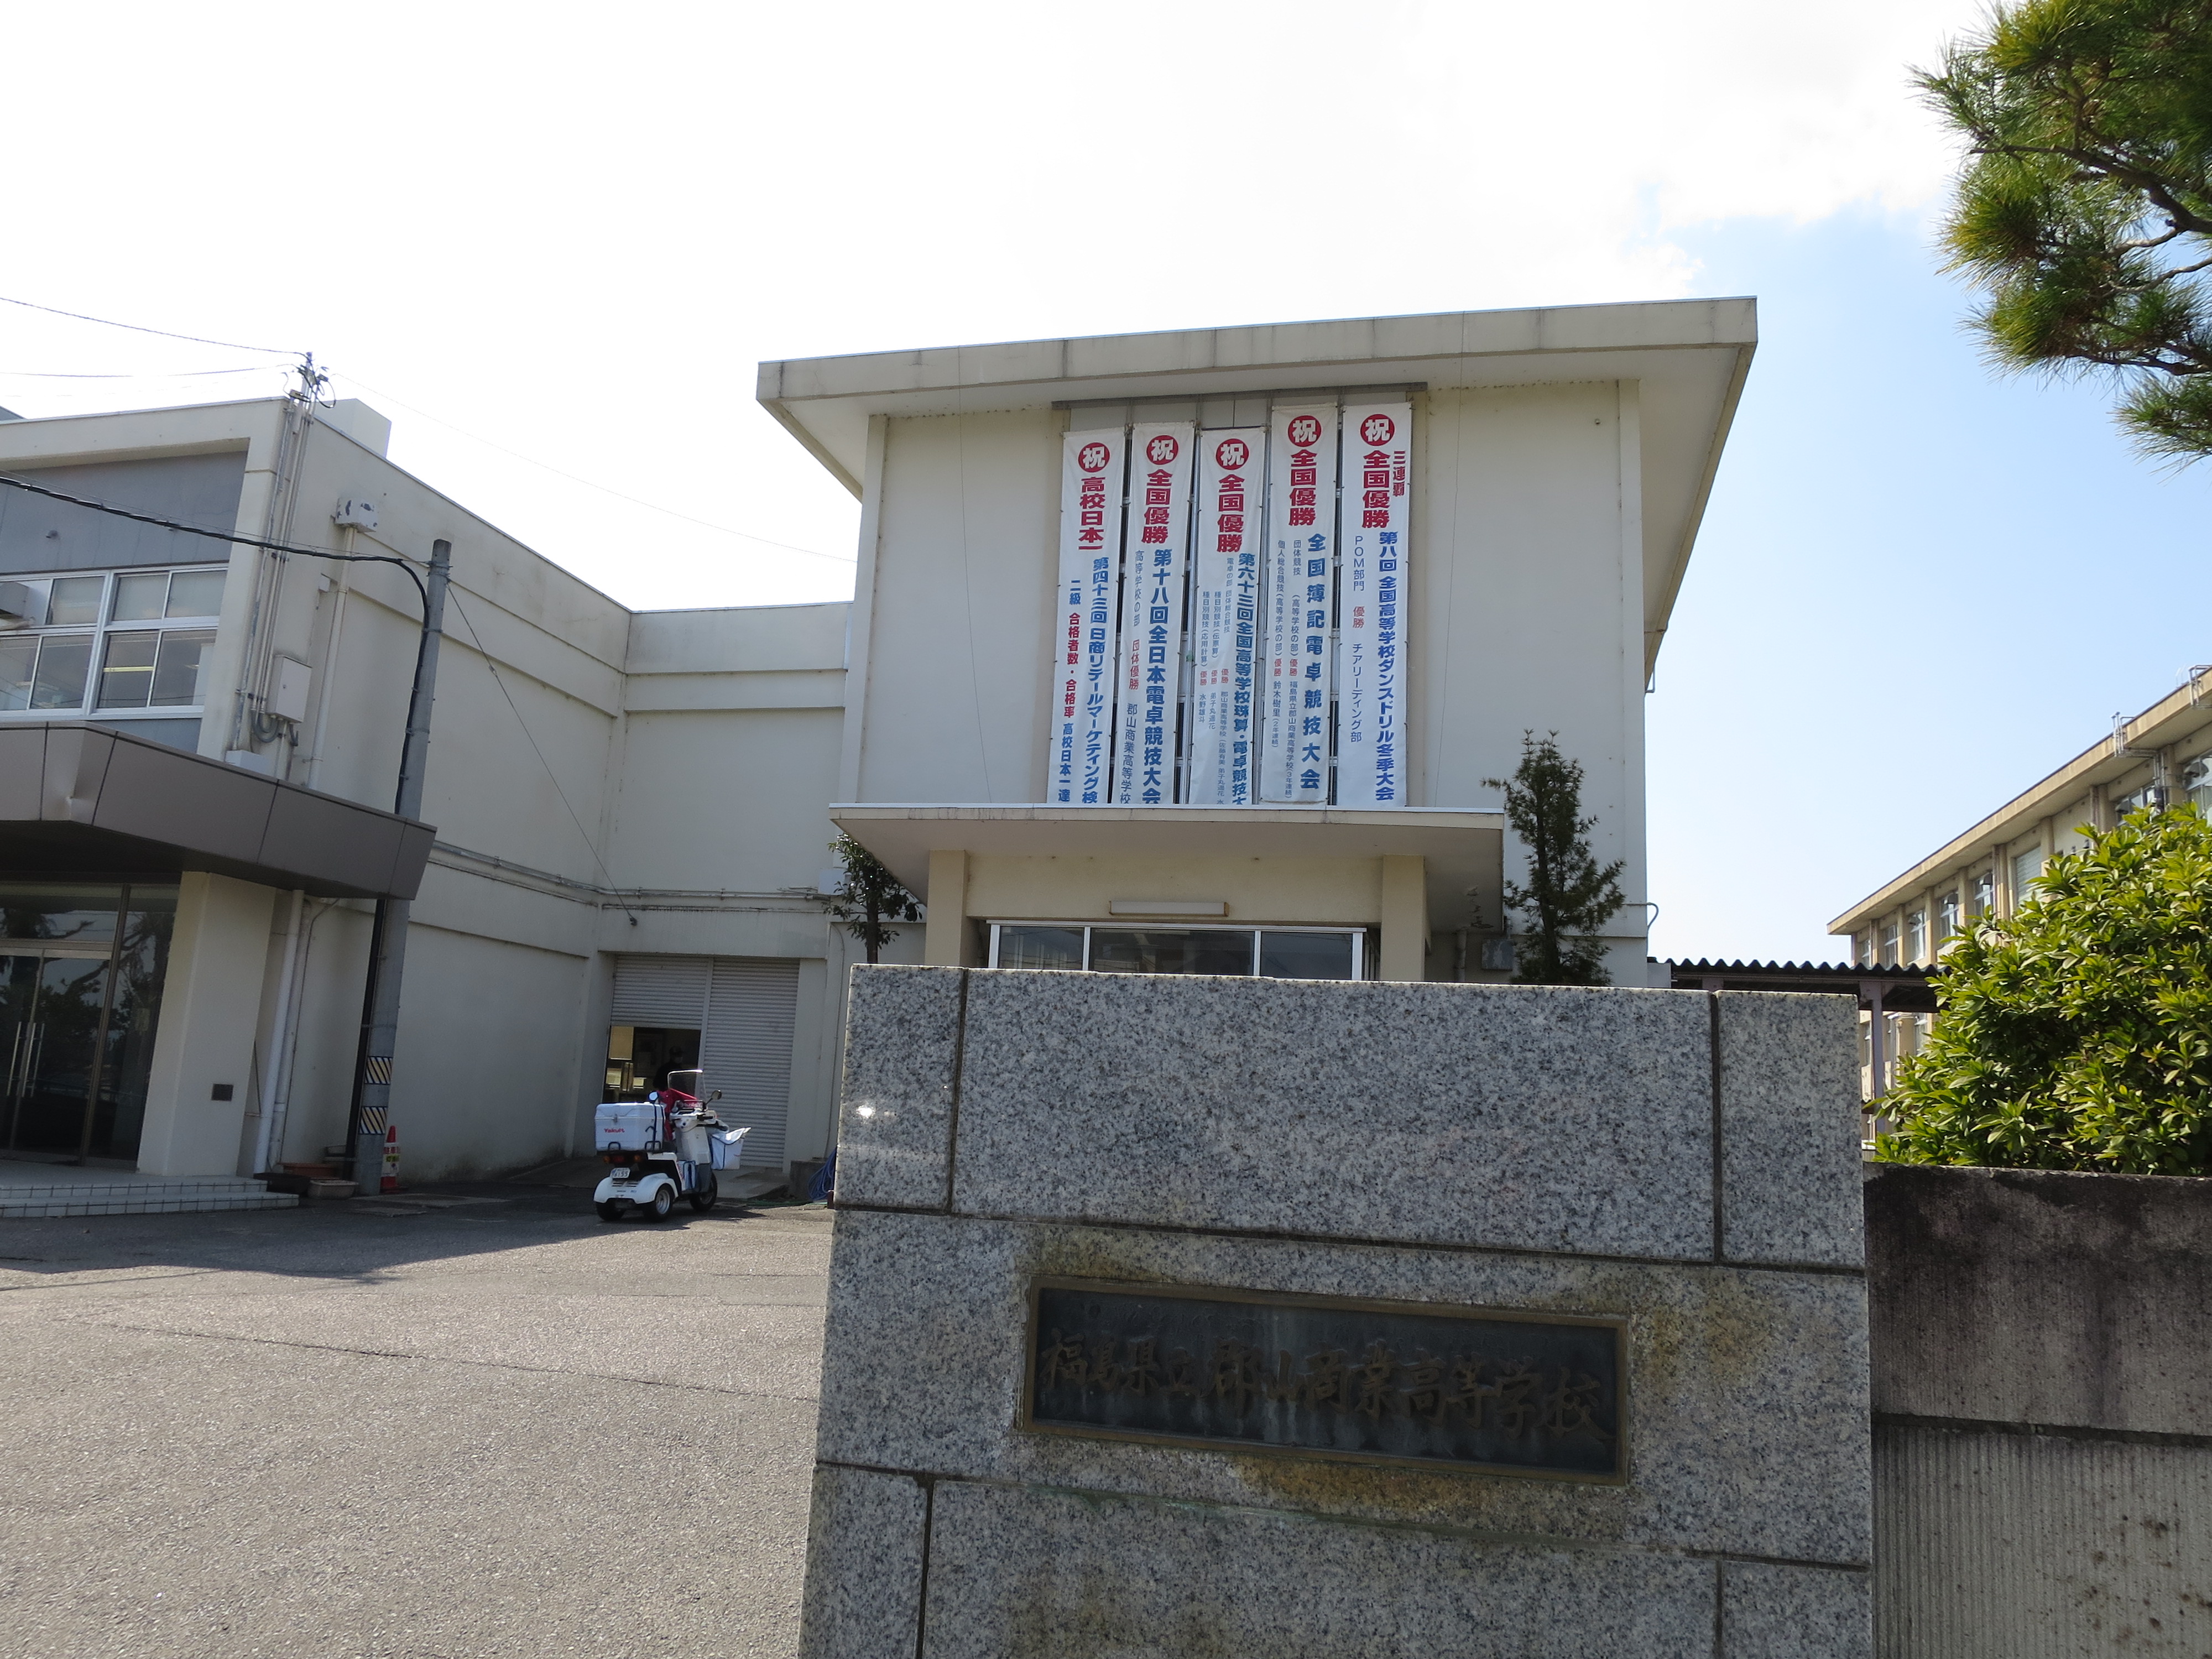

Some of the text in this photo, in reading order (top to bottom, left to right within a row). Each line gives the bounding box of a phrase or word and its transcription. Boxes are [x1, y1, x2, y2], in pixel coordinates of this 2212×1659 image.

[1083, 446, 1105, 468] 祝
[1151, 439, 1173, 461] 祝
[1220, 443, 1244, 466] 祝
[1293, 419, 1317, 443] 祝
[1365, 419, 1390, 442] 祝
[1141, 469, 1173, 544] 全国優勝
[1288, 449, 1317, 526] 全国優勝
[1361, 450, 1391, 529] 全国優勝
[1392, 451, 1406, 497] 三連覇
[1078, 477, 1106, 550] 高校日本一
[1217, 474, 1245, 552] 全国優勝
[1064, 612, 1081, 718] 合格者数・合格率
[1142, 549, 1172, 804] 第十八回全日本電卓競技大会
[1274, 658, 1282, 677] 優勝
[1289, 658, 1298, 676] 優勝
[1300, 533, 1327, 790] 全国簿記電卓競技大会
[1350, 535, 1365, 743] POM部門 優勝 チアリーディング部
[1376, 576, 1397, 801] 全国高等学校ダンスドリル冬季大会
[1120, 703, 1138, 804] 郡山商業高等学校
